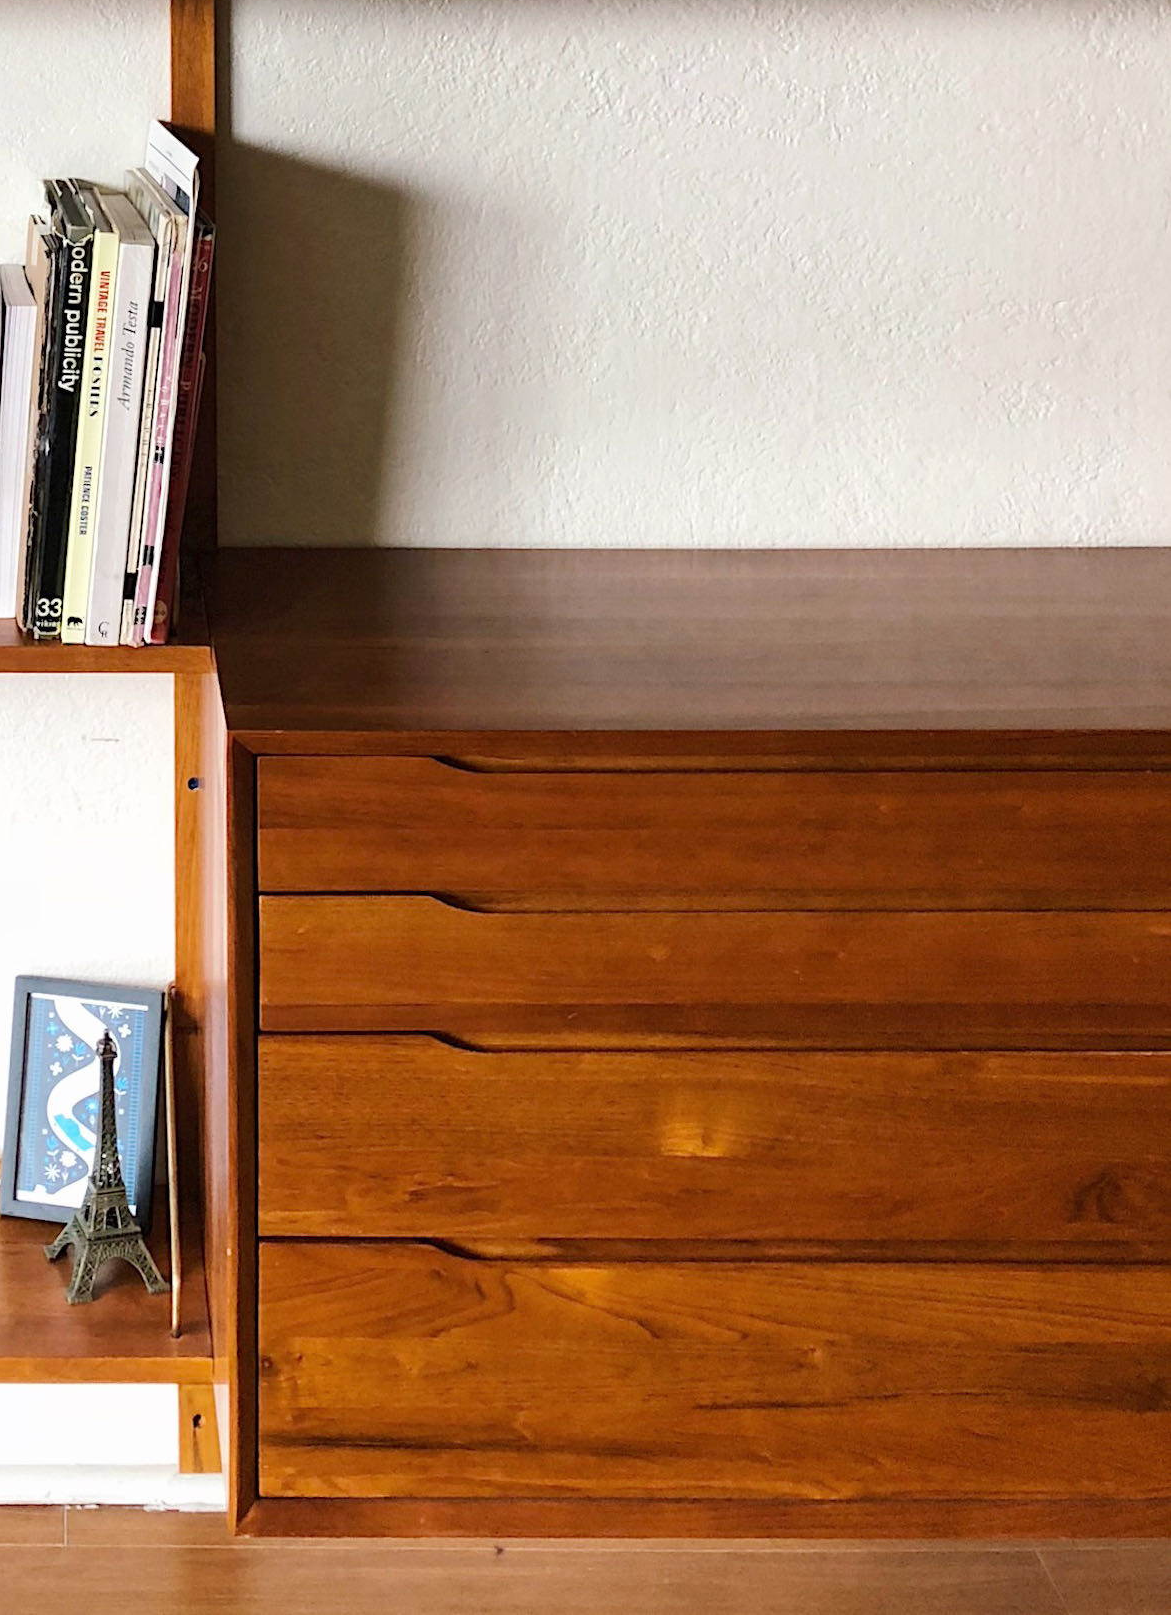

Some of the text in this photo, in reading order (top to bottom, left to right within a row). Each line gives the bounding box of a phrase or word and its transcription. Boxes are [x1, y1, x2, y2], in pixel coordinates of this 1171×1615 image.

[57, 308, 84, 394] publicity
[116, 300, 139, 412] Armando Testa
[79, 270, 111, 536] VINTAGE TRAVEL POSTERS PATIENCE COSTER
[37, 597, 62, 617] 33
